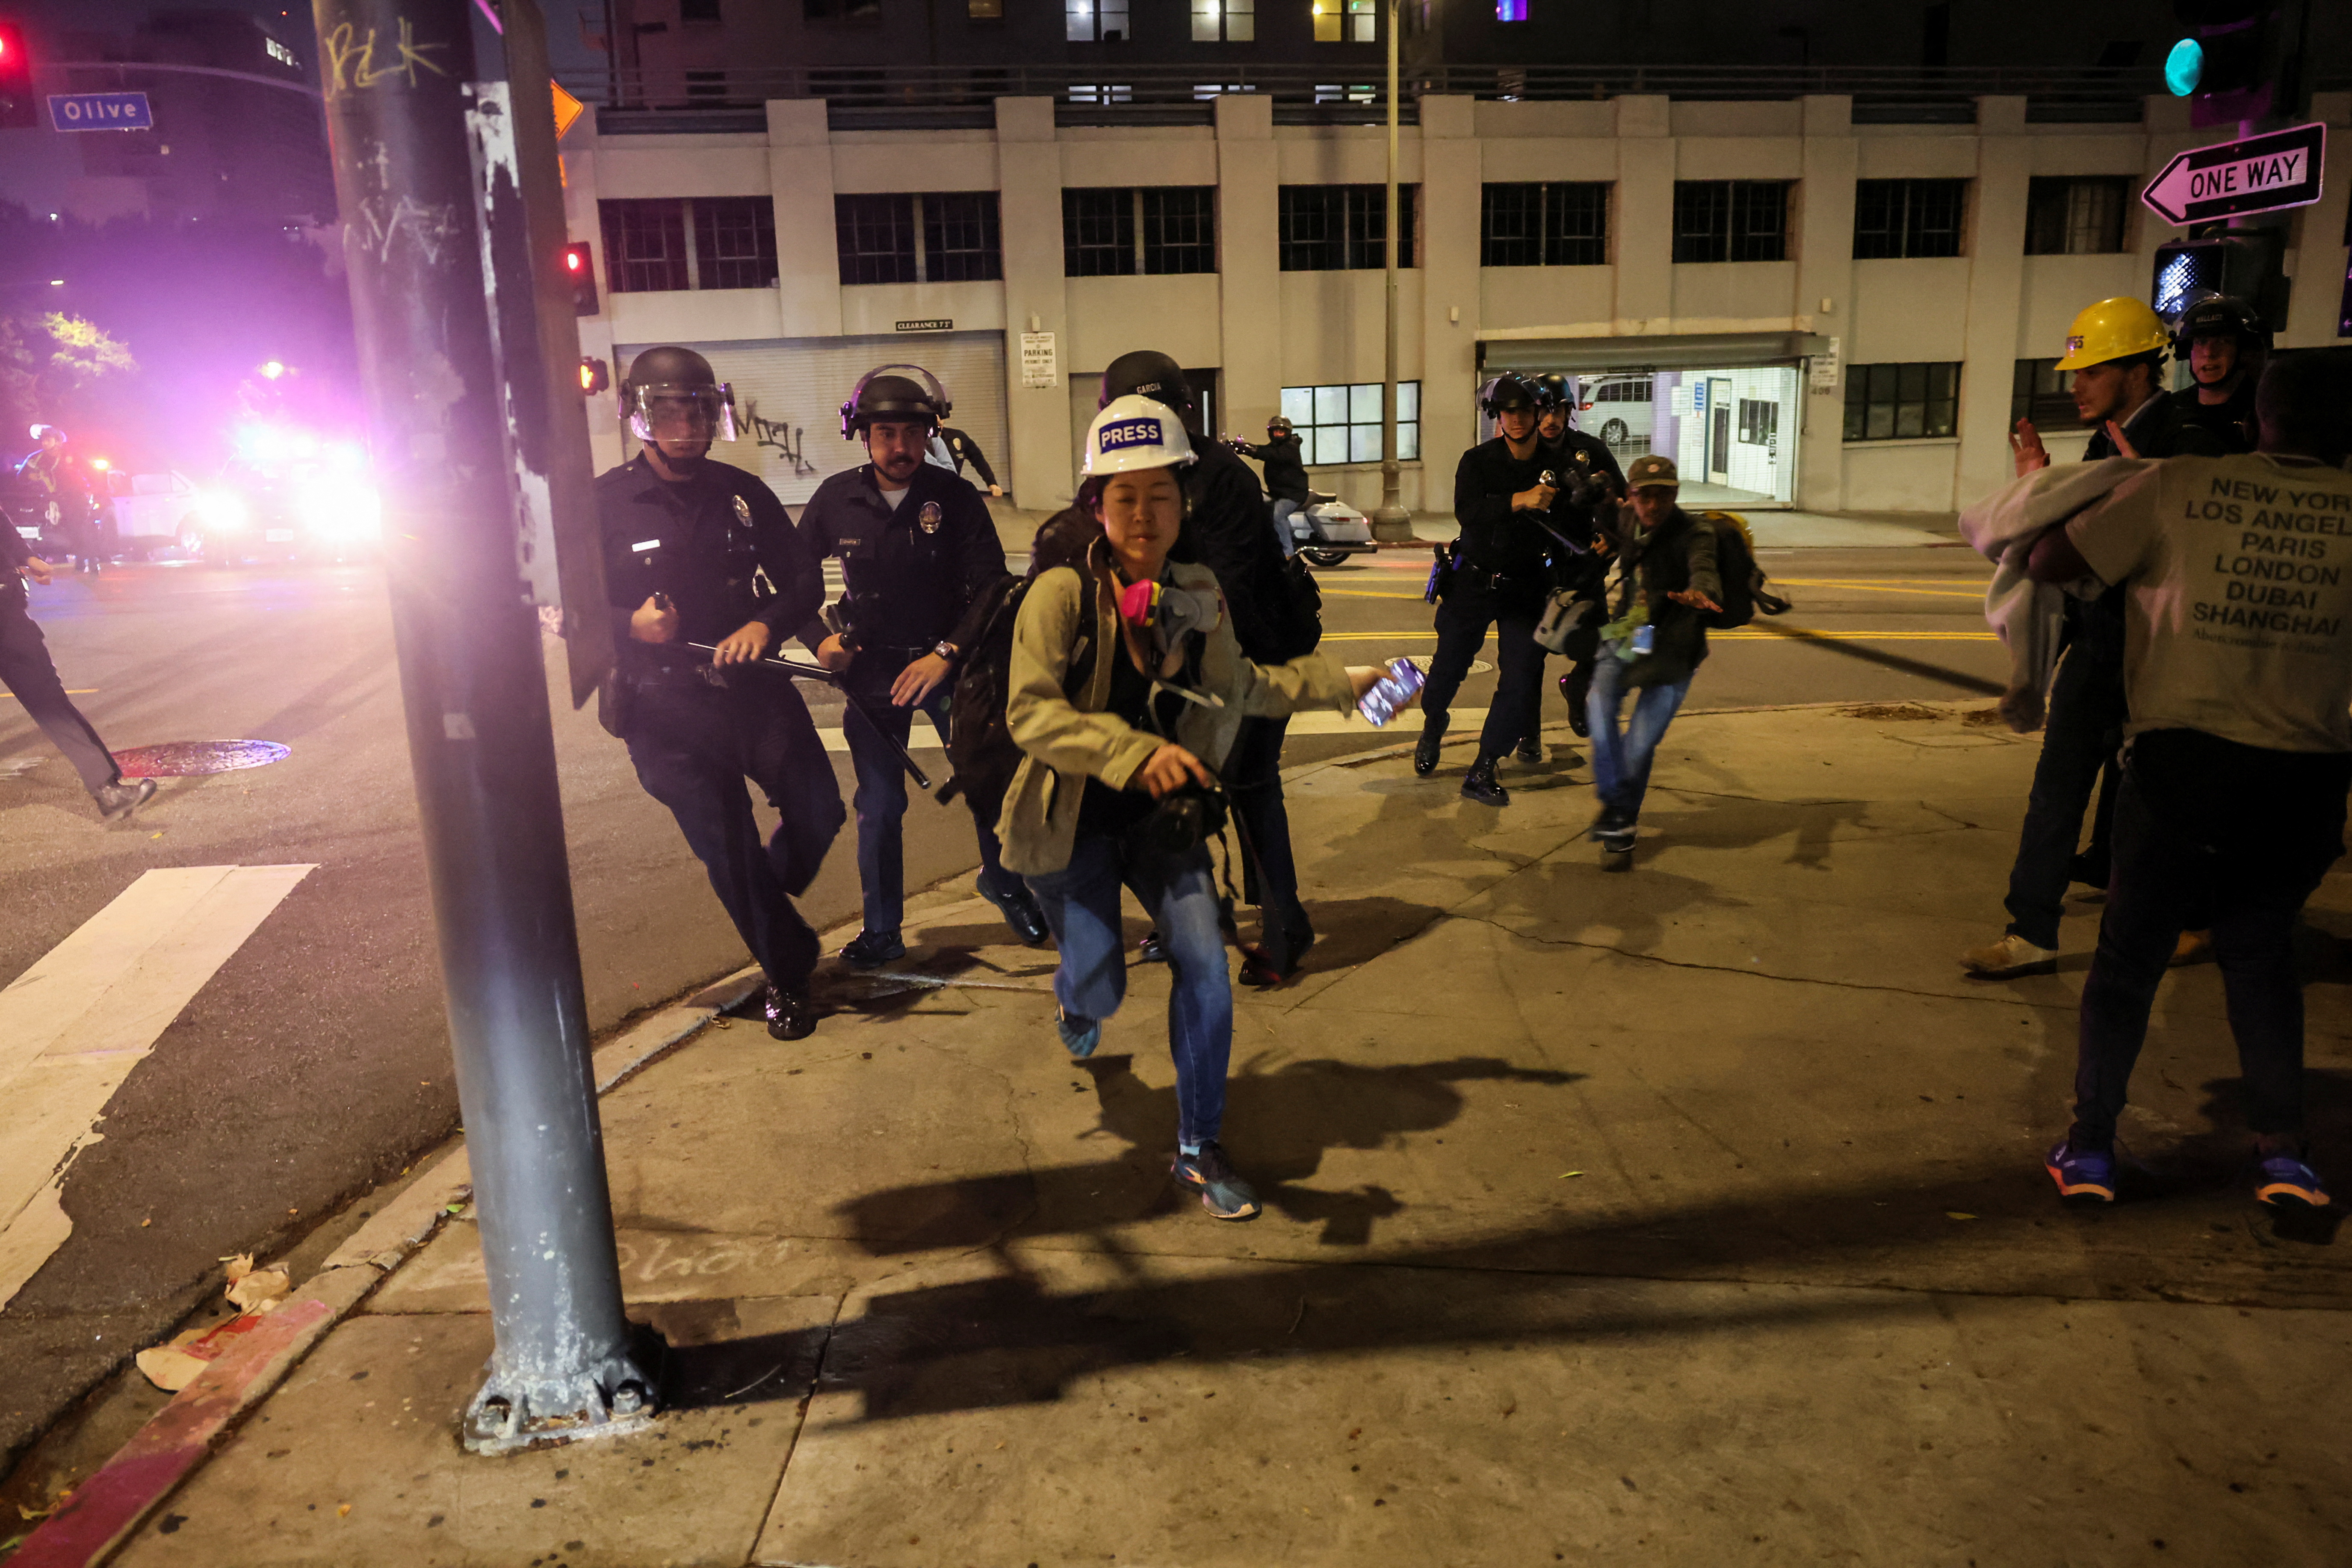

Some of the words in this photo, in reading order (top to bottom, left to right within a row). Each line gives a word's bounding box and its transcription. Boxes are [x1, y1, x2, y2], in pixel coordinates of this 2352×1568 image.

[65, 100, 136, 120] Olive
[2191, 166, 2237, 198] ONE
[2248, 154, 2299, 188] WAY
[898, 321, 937, 329] CLEARANCE
[1137, 382, 1161, 394] GARCIA
[1101, 424, 1158, 448] PRESS
[2211, 478, 2279, 505] NEW
[2185, 500, 2243, 524] LOS
[2241, 532, 2326, 559] PARIS
[2215, 554, 2341, 586] LONDON
[2226, 580, 2318, 610] DUBAI
[2193, 602, 2340, 637] SHANGHAI
